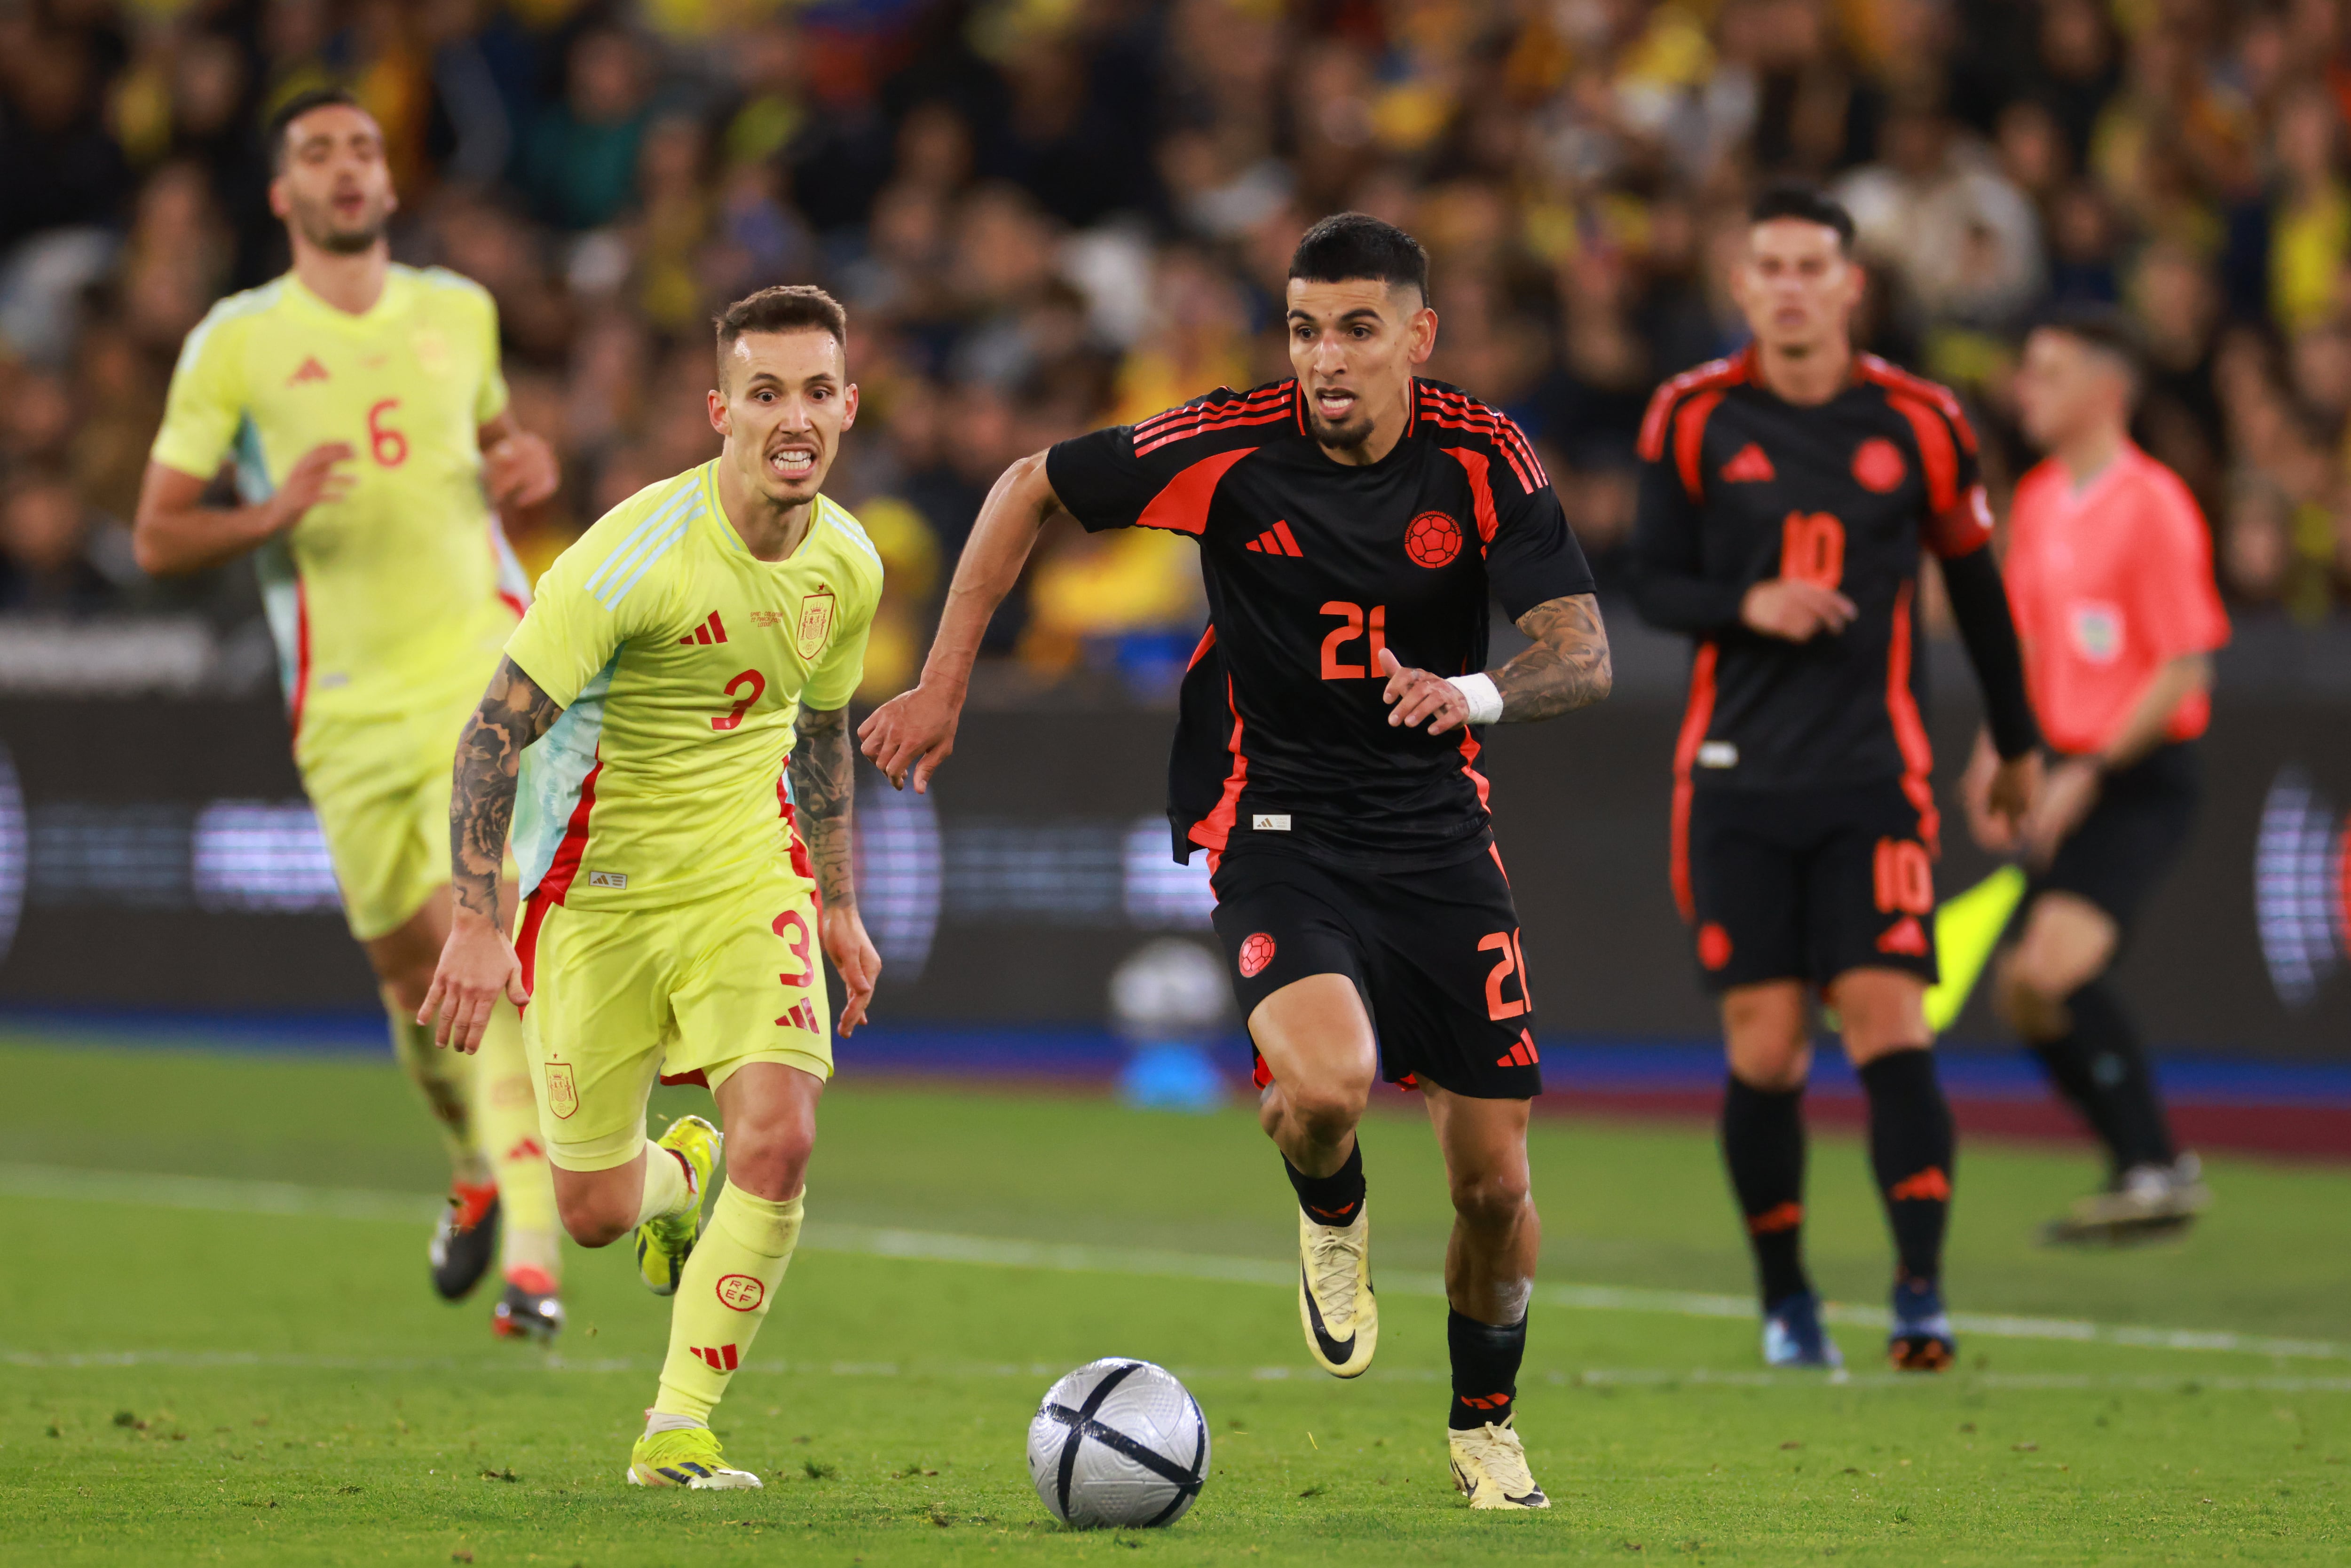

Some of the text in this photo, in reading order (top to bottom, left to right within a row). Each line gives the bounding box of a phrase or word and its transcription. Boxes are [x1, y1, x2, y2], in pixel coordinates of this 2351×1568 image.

[367, 398, 410, 467] 6
[1780, 509, 1845, 591] 10
[1319, 601, 1388, 680] 21
[711, 669, 765, 730] 3
[1873, 835, 1934, 914] 10
[772, 910, 814, 988] 3
[1477, 927, 1532, 1021] 21
